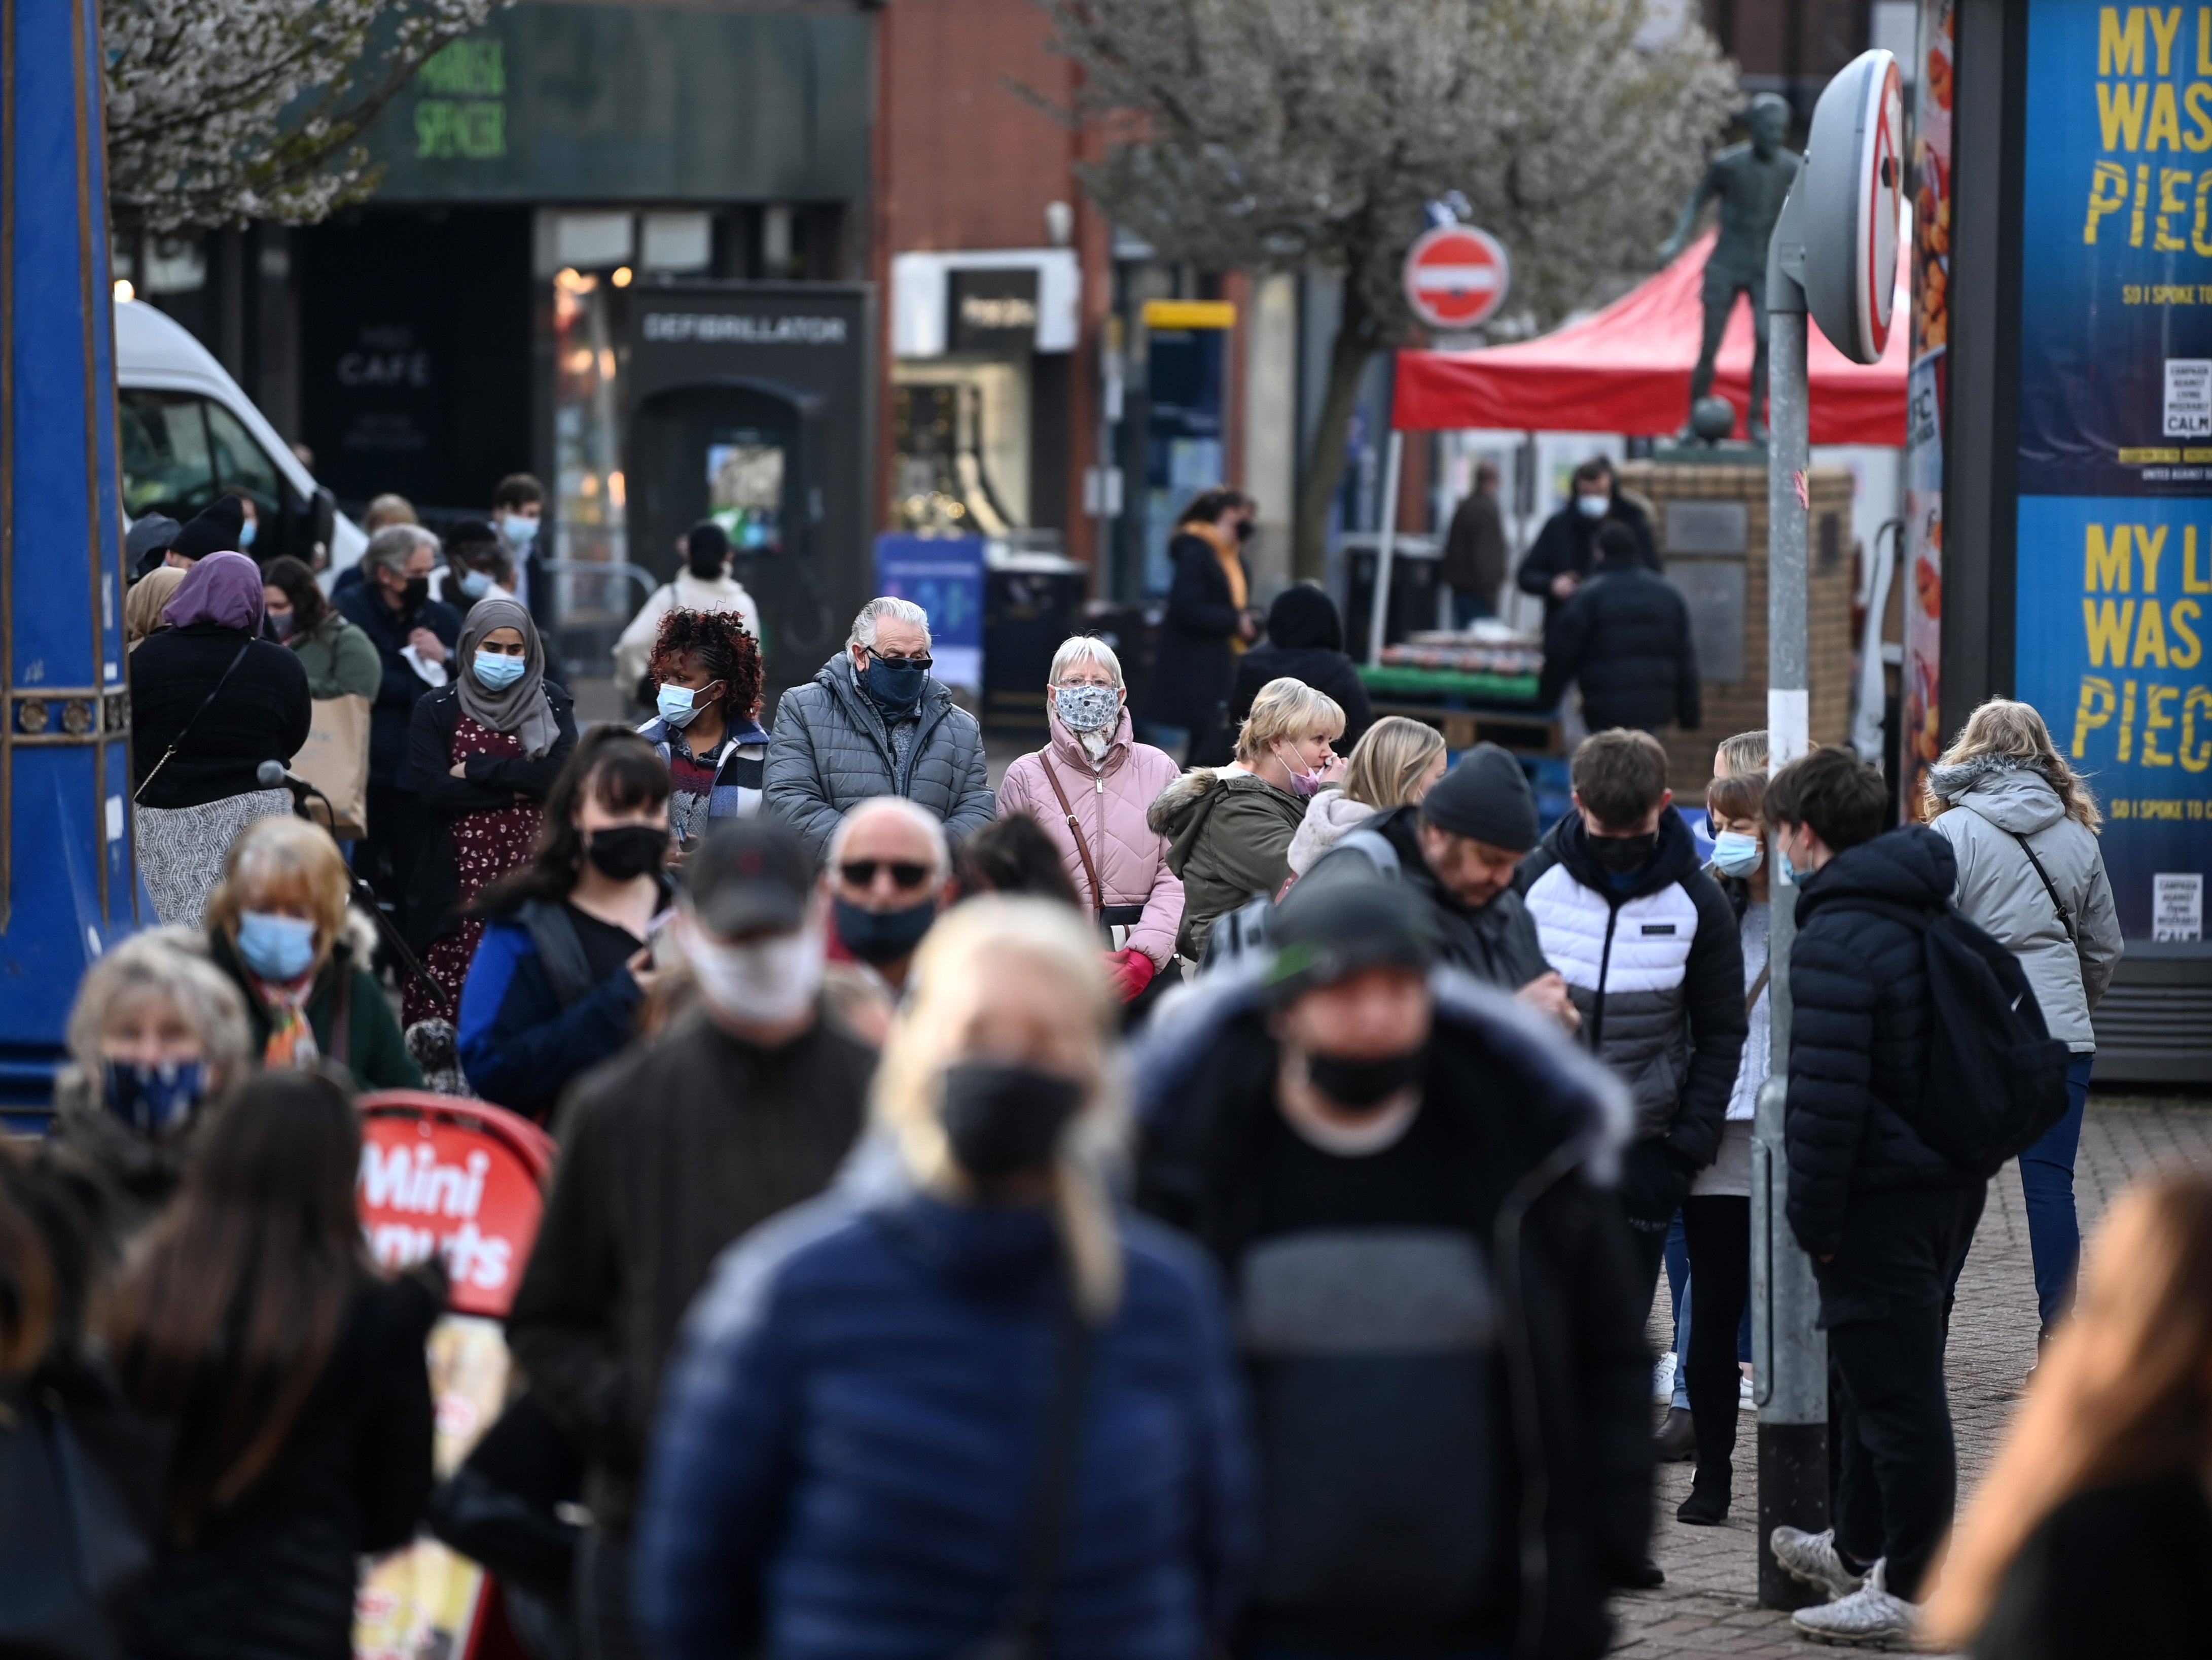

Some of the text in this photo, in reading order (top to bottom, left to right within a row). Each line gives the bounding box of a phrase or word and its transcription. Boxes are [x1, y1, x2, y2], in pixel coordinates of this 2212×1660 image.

[2097, 7, 2182, 76] MY
[2095, 82, 2212, 152] WAS
[644, 313, 846, 344] DEFIBRILLATOR
[2123, 285, 2141, 304] SO
[2145, 285, 2149, 304] I
[1908, 387, 1932, 430] FC
[2168, 416, 2209, 431] CALM
[2085, 523, 2212, 594] MY L
[2083, 599, 2202, 669] WAS
[2072, 676, 2212, 772] PIEC
[2111, 799, 2129, 819] SO
[2132, 800, 2137, 819] I
[2140, 799, 2183, 819] SPOKE
[2188, 800, 2203, 820] TO
[358, 1141, 490, 1218] Mini
[360, 1221, 511, 1289] nuts
